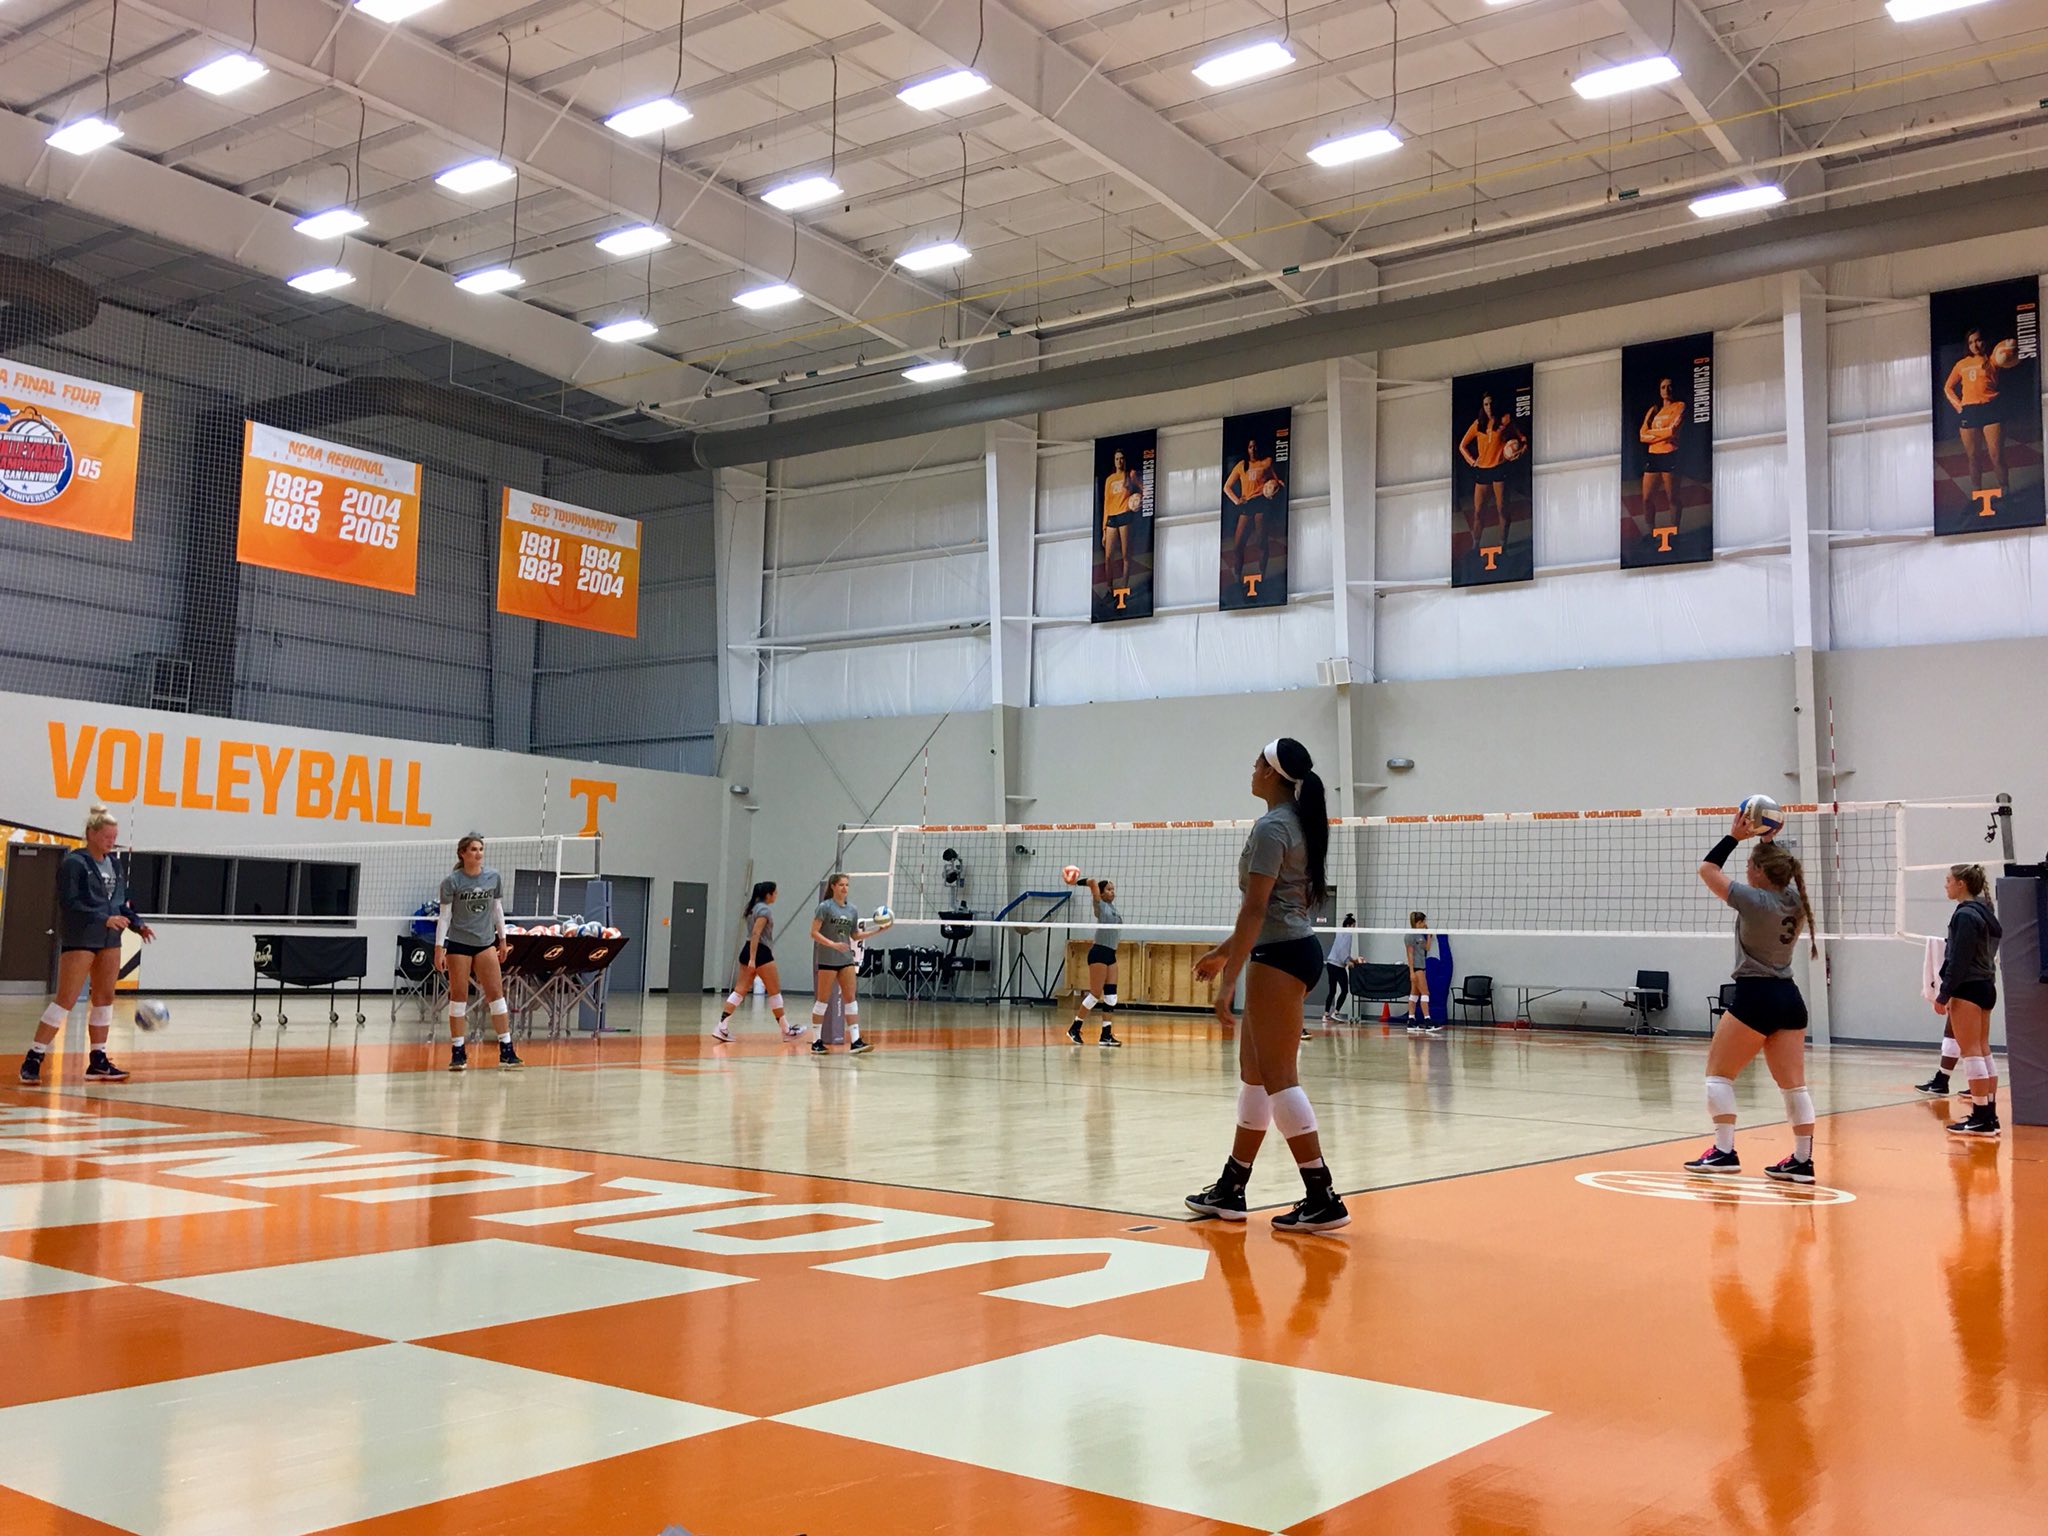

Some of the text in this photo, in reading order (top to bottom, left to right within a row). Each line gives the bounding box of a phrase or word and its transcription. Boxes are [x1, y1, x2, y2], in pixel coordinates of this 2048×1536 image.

[2016, 311, 2037, 361] WILLIAMS
[13, 371, 56, 396] FINAL
[62, 384, 102, 406] FOUR
[1693, 364, 1710, 424] SCHUMACHER
[1516, 395, 1530, 418] BUSS
[0, 440, 65, 460] OLLEYBALL
[287, 440, 323, 461] NCAA
[326, 450, 385, 477] REGIONAL
[1276, 440, 1289, 463] JETER
[0, 456, 64, 474] AMPIONSHIP
[5, 470, 58, 482] SAN ANTONIO
[78, 458, 102, 480] 05
[5, 486, 59, 503] ANNIVERSARY
[265, 470, 402, 523] 1982 2004
[1971, 488, 2002, 517] T
[264, 498, 400, 550] 1983 2005
[530, 503, 550, 519] SEC
[553, 508, 618, 535] TOURNAMENT
[519, 531, 622, 574] 1981 1984
[1653, 526, 1678, 552] T
[1480, 545, 1502, 571] T
[518, 555, 624, 599] 1982 2004
[1243, 574, 1262, 597] T
[1113, 587, 1131, 609] T
[48, 721, 432, 827] VOLLEYBALL
[570, 779, 617, 837] T
[1584, 809, 1642, 818] VOLUNTEERS
[1779, 915, 1799, 945] 3
